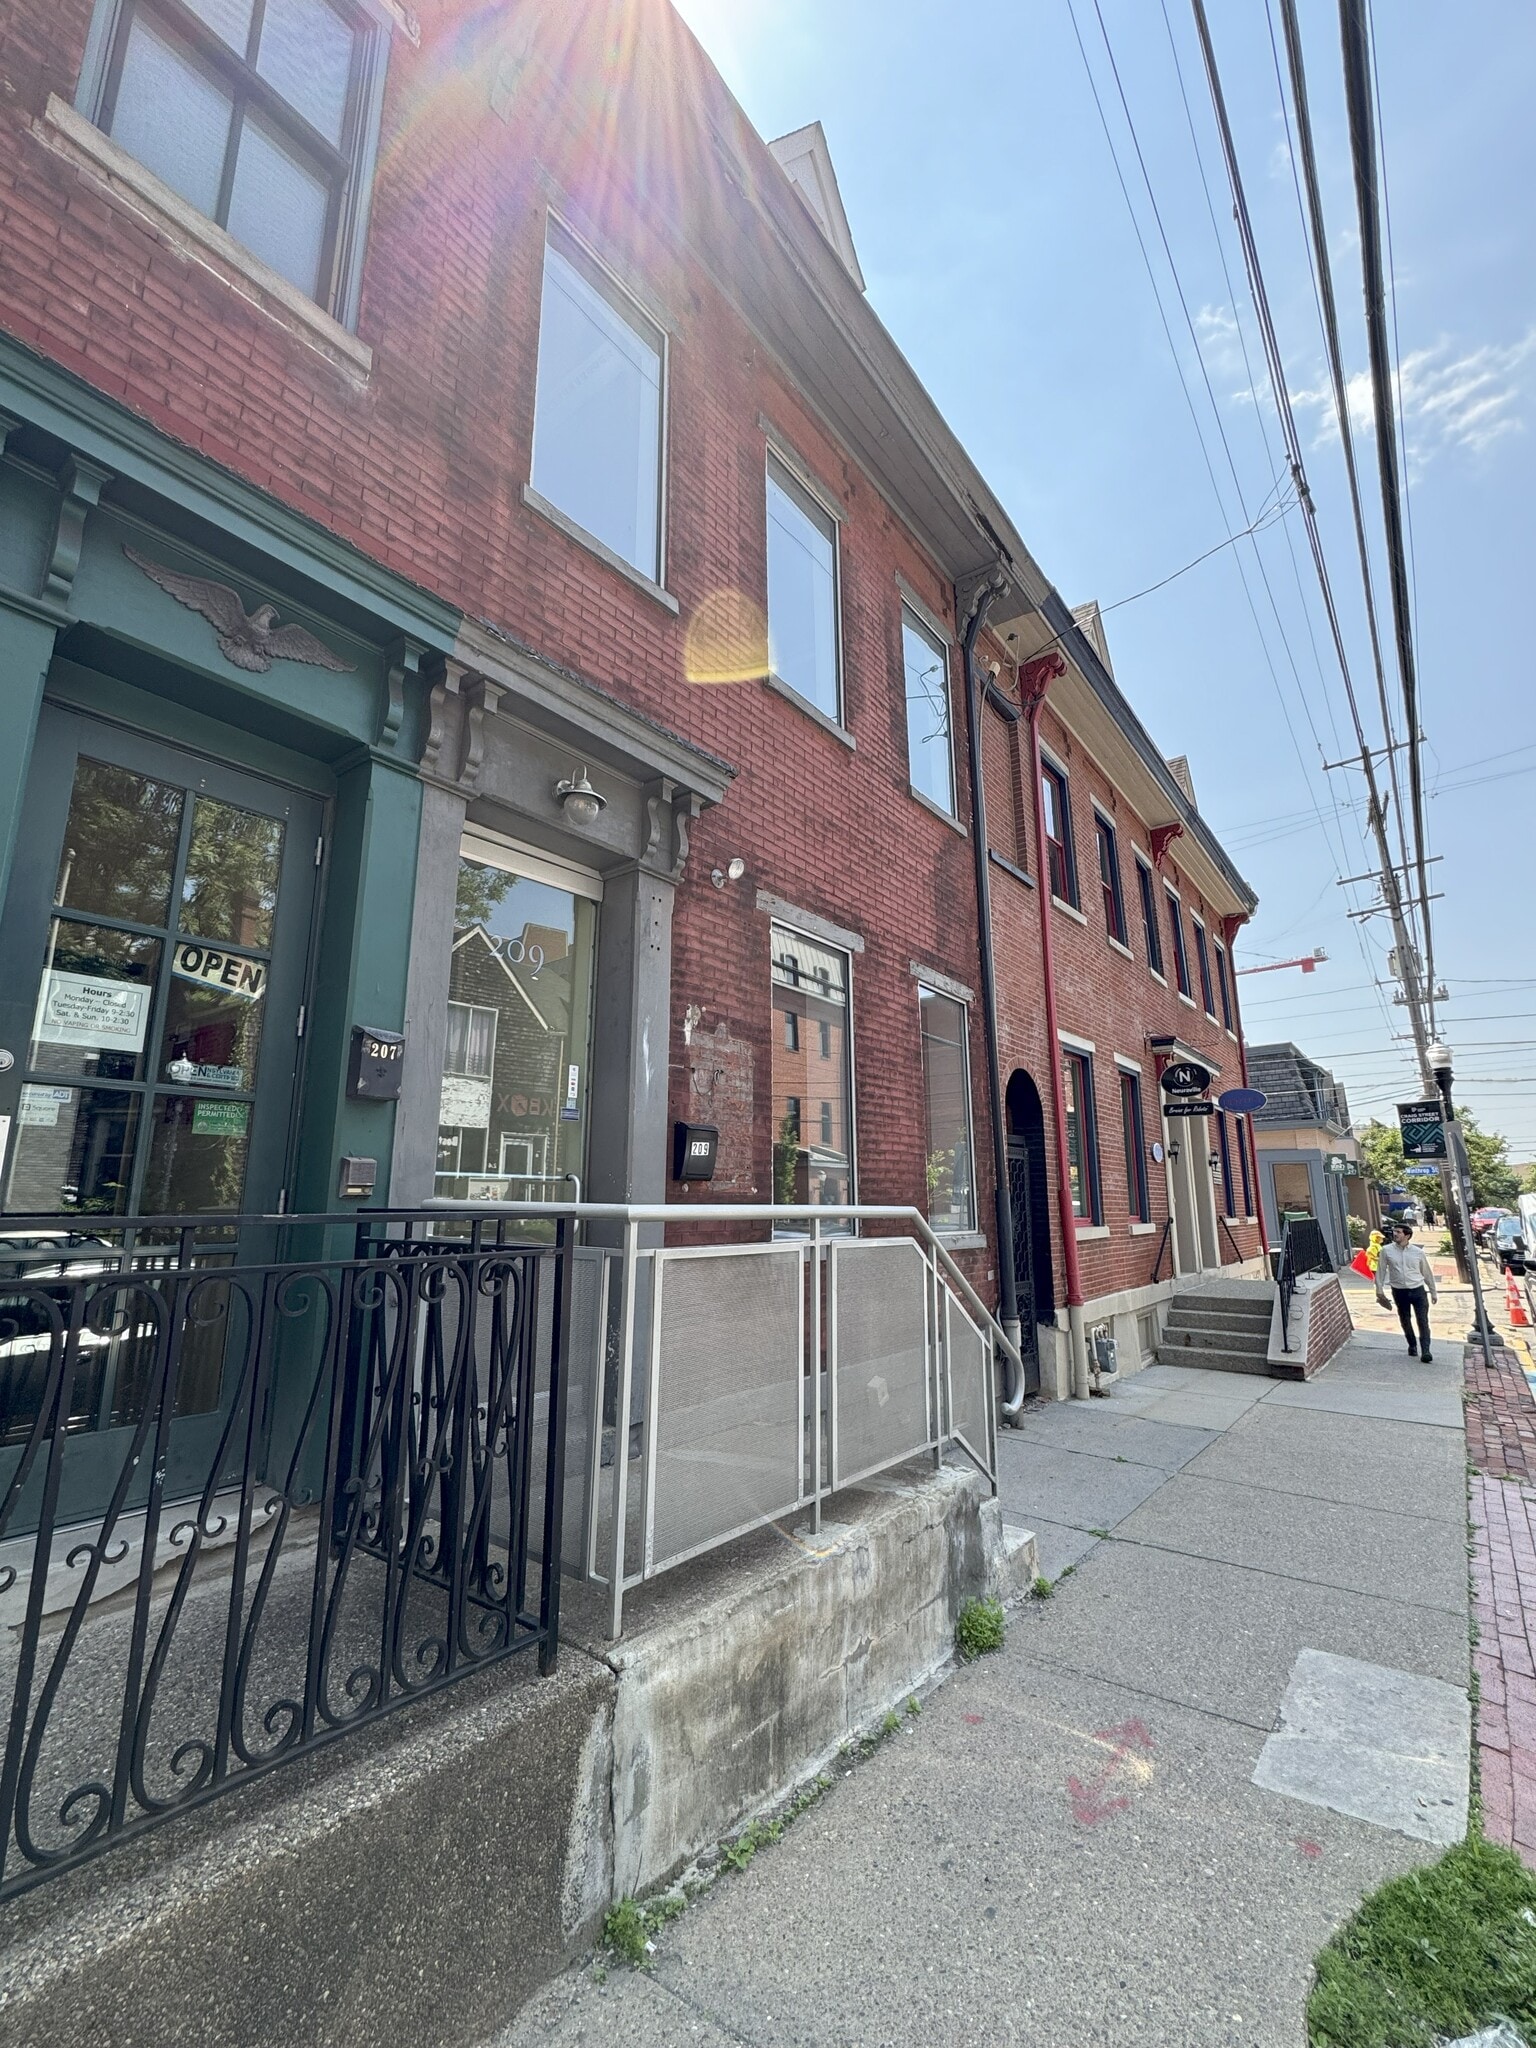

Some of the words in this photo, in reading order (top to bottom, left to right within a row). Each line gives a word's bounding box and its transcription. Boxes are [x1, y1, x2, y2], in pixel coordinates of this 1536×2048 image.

[489, 934, 545, 976] 209
[180, 944, 262, 993] OPEN
[82, 986, 112, 998] Hours
[64, 993, 94, 1005] Monday
[52, 1000, 110, 1015] Tuesday-Friday
[111, 1008, 135, 1018] 9-2:30
[56, 1009, 71, 1018] Sat.
[82, 1013, 99, 1022] Sun.
[101, 1015, 130, 1026] 10-2:30
[64, 1019, 89, 1028] VAPING
[90, 1022, 100, 1030] OR
[101, 1024, 131, 1034] SMOKING
[370, 1043, 397, 1060] 207
[1179, 1070, 1191, 1083] N
[53, 1090, 70, 1099] ADT
[197, 1109, 236, 1119] PERMITTED
[198, 1103, 237, 1112] INSPECTED
[1401, 1116, 1440, 1124] CORRIDOR
[692, 1142, 709, 1155] 209
